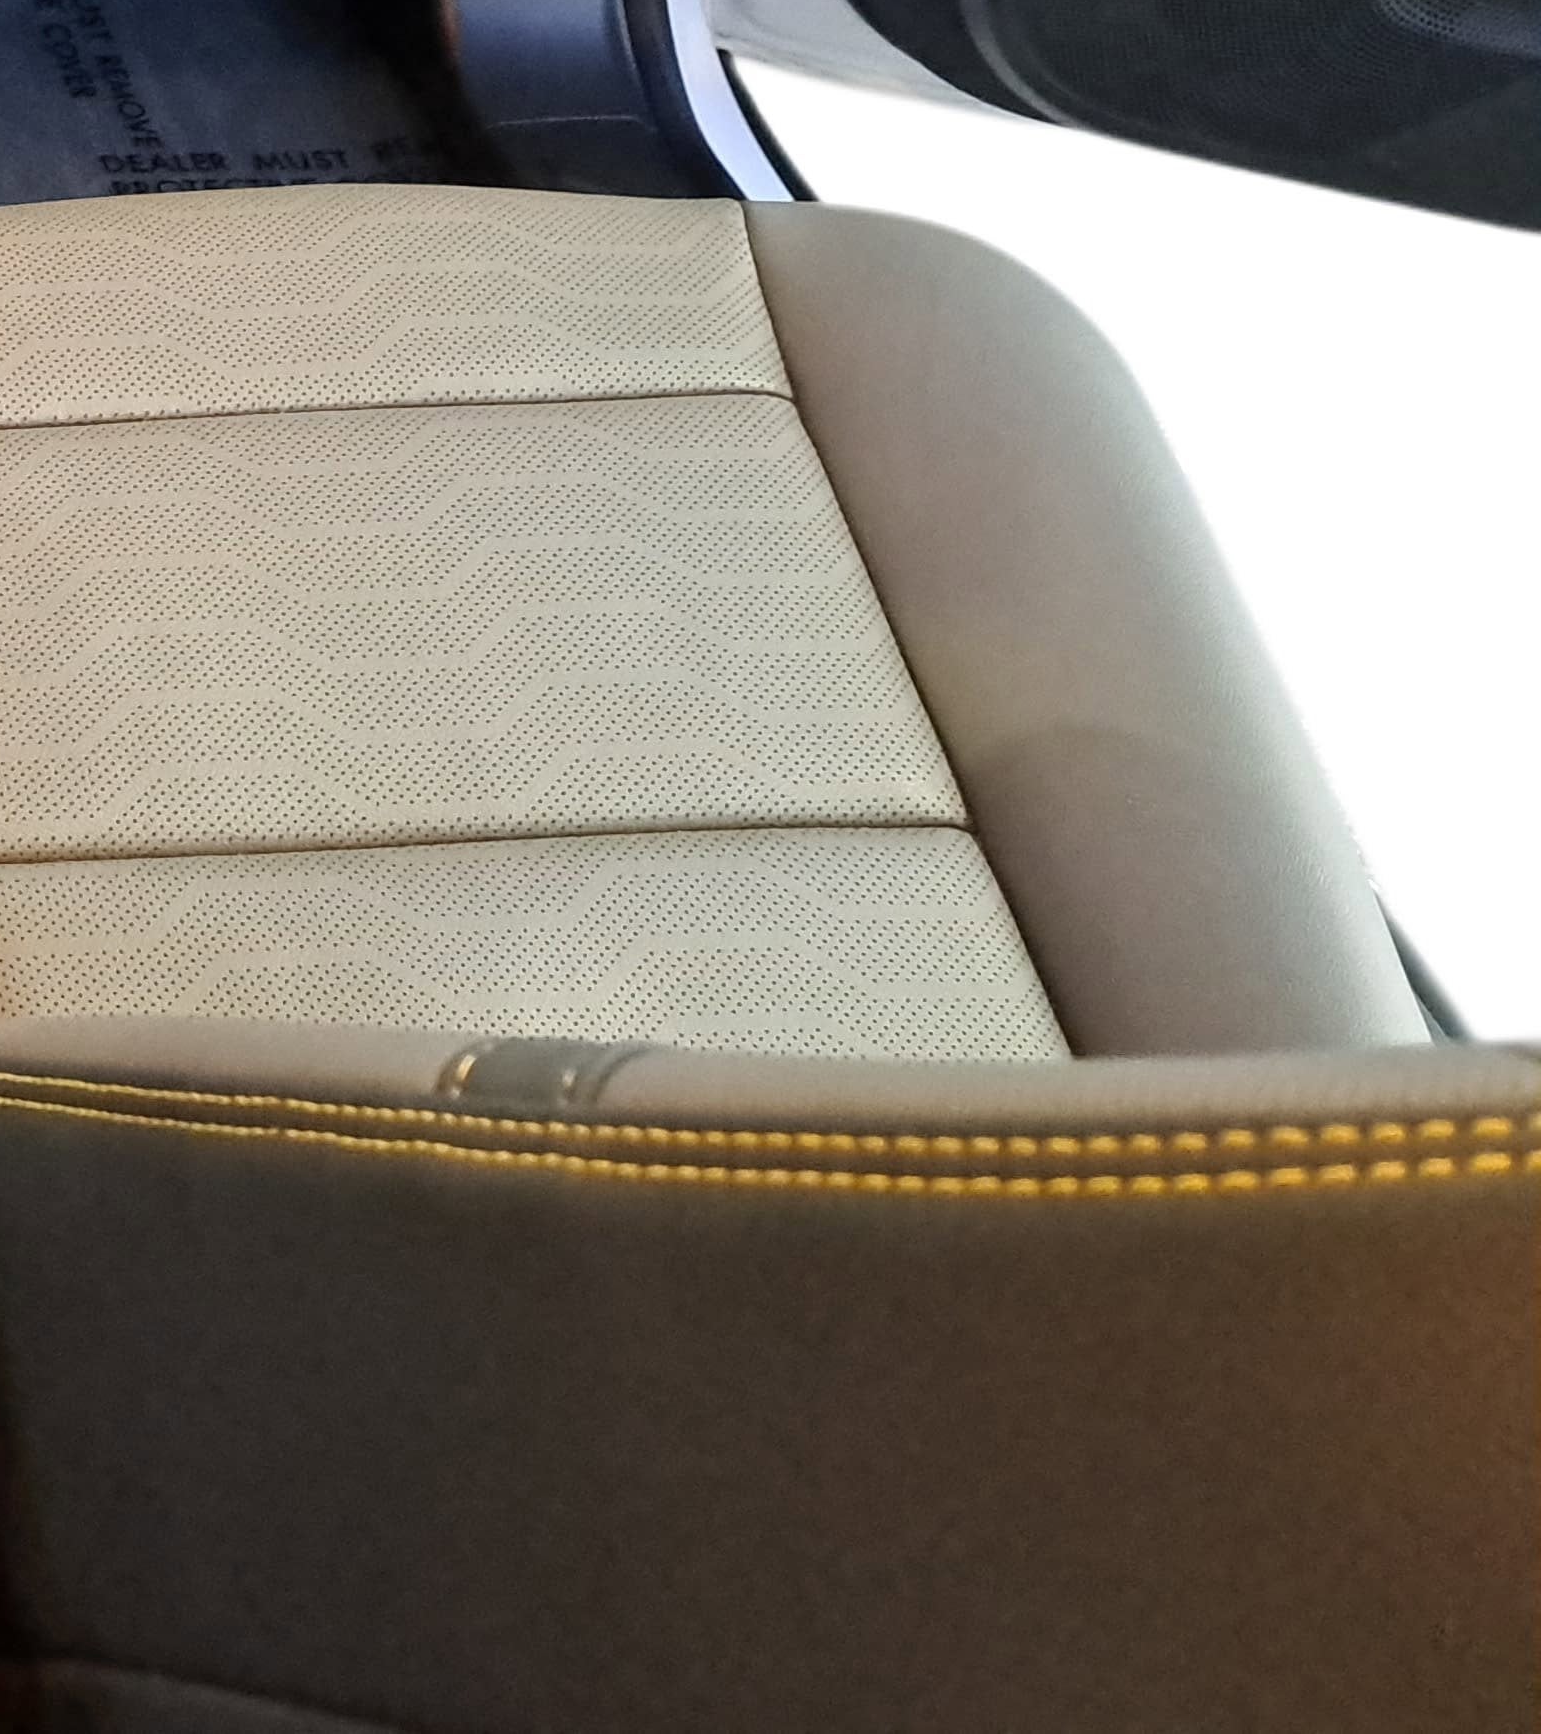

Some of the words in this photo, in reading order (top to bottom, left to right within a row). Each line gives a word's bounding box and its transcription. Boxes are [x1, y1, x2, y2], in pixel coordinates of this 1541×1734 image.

[41, 21, 97, 99] COVER
[96, 54, 164, 147] REMOVE
[97, 151, 231, 176] DEALER
[252, 148, 351, 172] MUST
